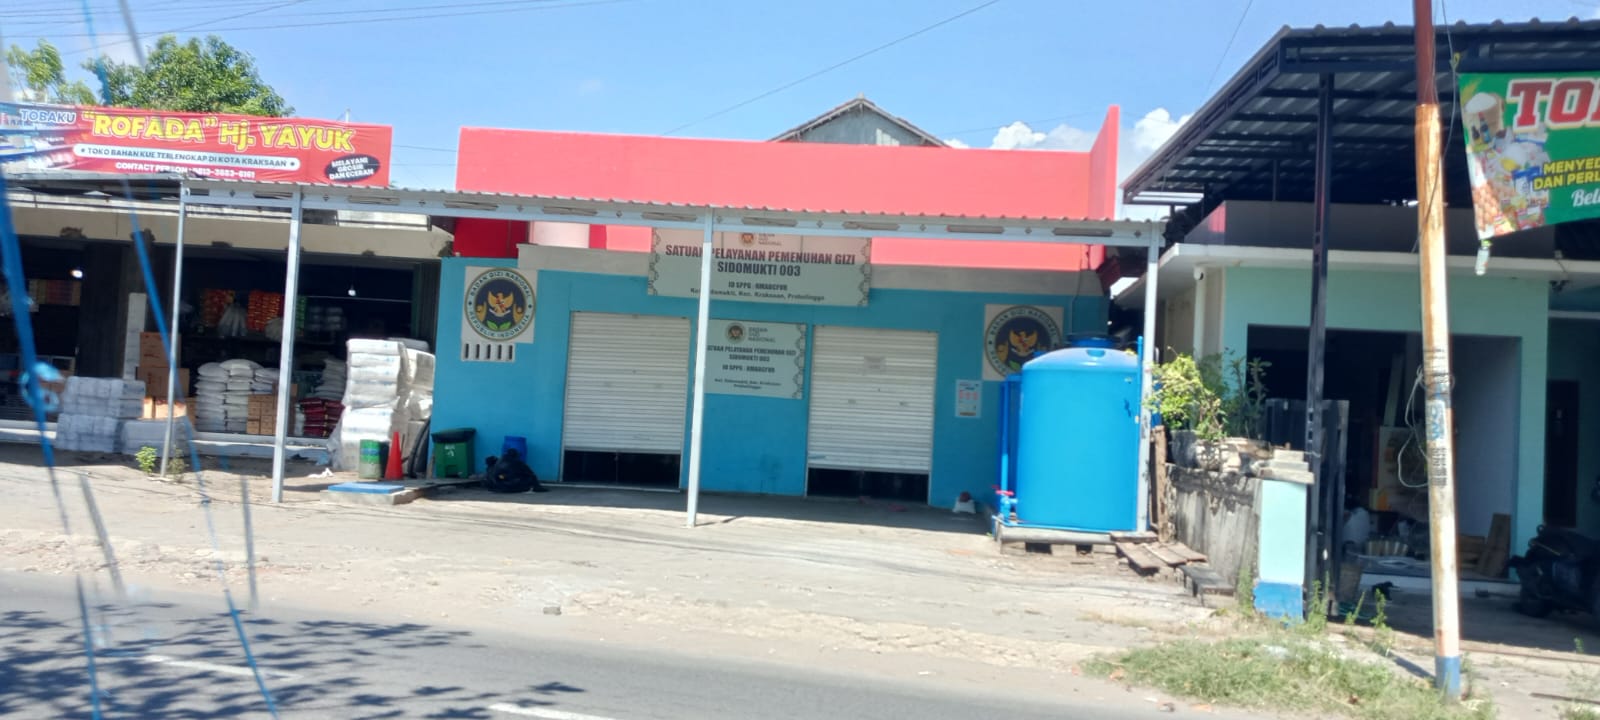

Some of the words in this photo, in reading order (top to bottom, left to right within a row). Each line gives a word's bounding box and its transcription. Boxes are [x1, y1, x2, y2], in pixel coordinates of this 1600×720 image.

[1507, 77, 1600, 133] TO
[20, 109, 77, 125] TOBAKU
[219, 120, 256, 152] Hj.
[260, 124, 356, 152] YAYUK
[88, 147, 110, 155] TOKO
[111, 149, 140, 157] BAHAN
[140, 151, 156, 159] KUE
[208, 155, 217, 163] DI
[219, 156, 241, 164] KOTA
[242, 157, 287, 167] KRAKSAAN
[115, 162, 155, 172] CONTACT
[1533, 175, 1563, 190] DAN
[768, 251, 832, 265] PEMENUHAN
[834, 253, 856, 265] GIZI
[717, 261, 777, 275] SIDOMUKTI
[779, 264, 801, 277] 003
